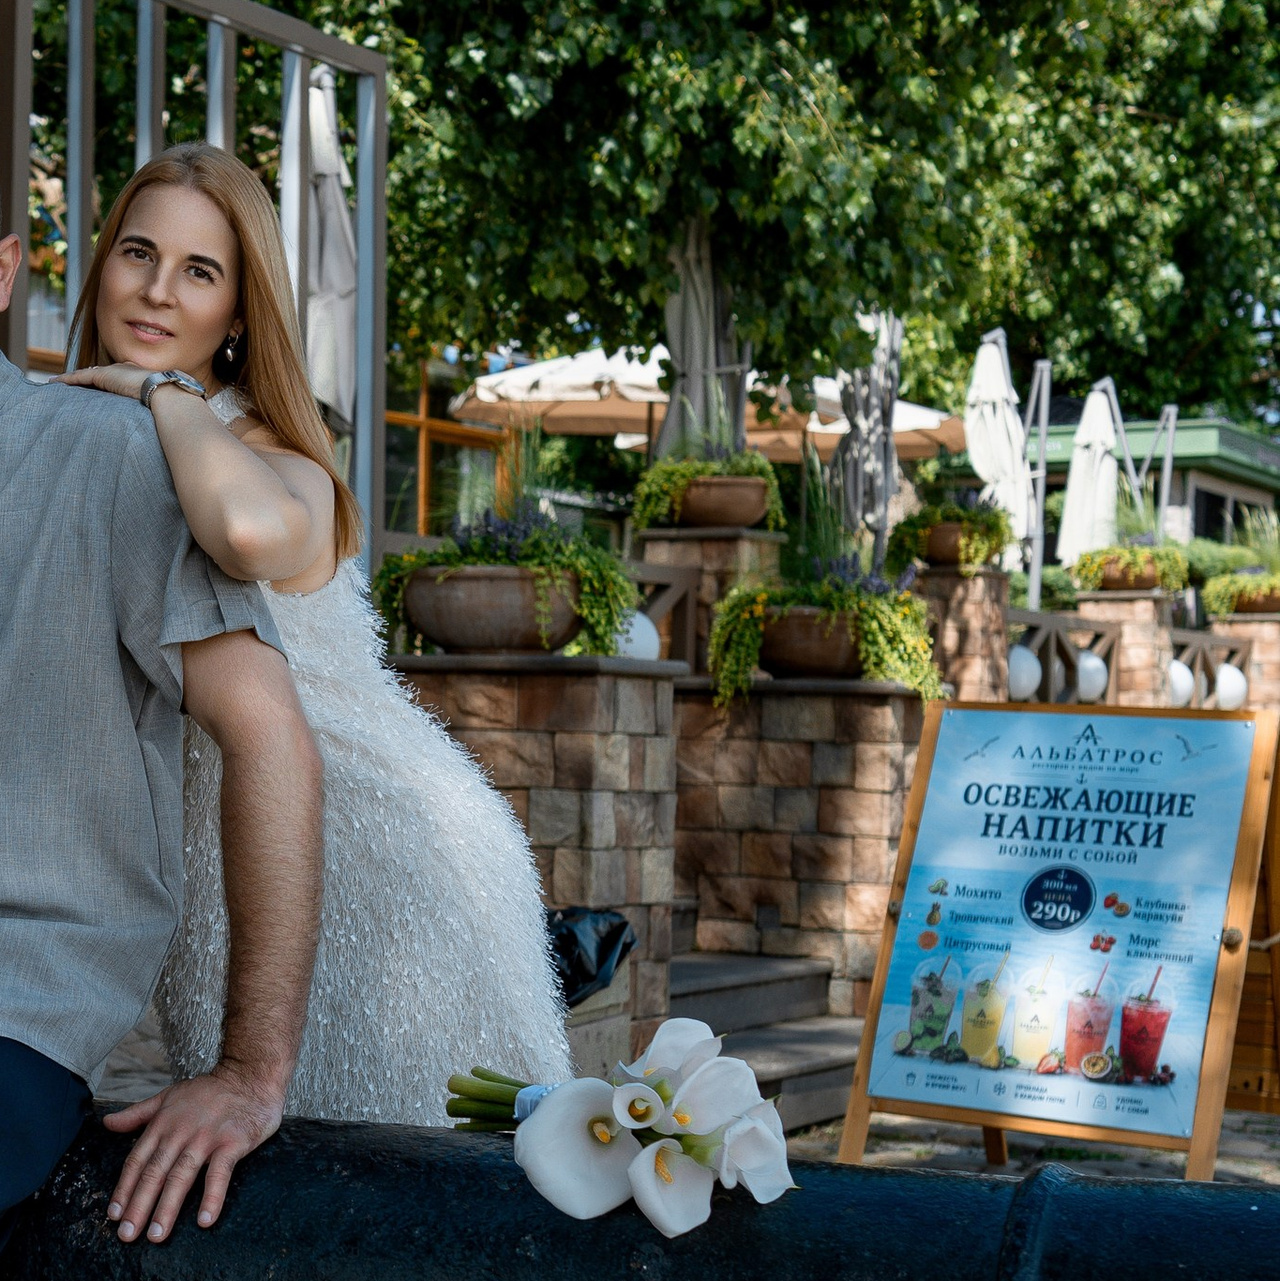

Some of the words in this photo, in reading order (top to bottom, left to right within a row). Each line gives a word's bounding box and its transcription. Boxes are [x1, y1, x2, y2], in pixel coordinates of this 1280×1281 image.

[1011, 745, 1163, 766] АЛЬБАТРОС
[963, 782, 1196, 819] ОСВЕЖАЮЩИЕ
[980, 812, 1168, 849] НАПИТКИ
[999, 844, 1063, 860] ВОЗЬМИ
[1069, 849, 1079, 861] С
[1083, 848, 1138, 865] СОБОЙ
[954, 884, 1002, 901] Мохито
[948, 910, 1014, 926] Тропический
[1031, 900, 1081, 923] 290р
[1133, 910, 1184, 924] маракуйя
[943, 935, 1012, 953] Цитрусовый
[1128, 933, 1161, 949] Морс
[1126, 950, 1193, 965] клюквенный
